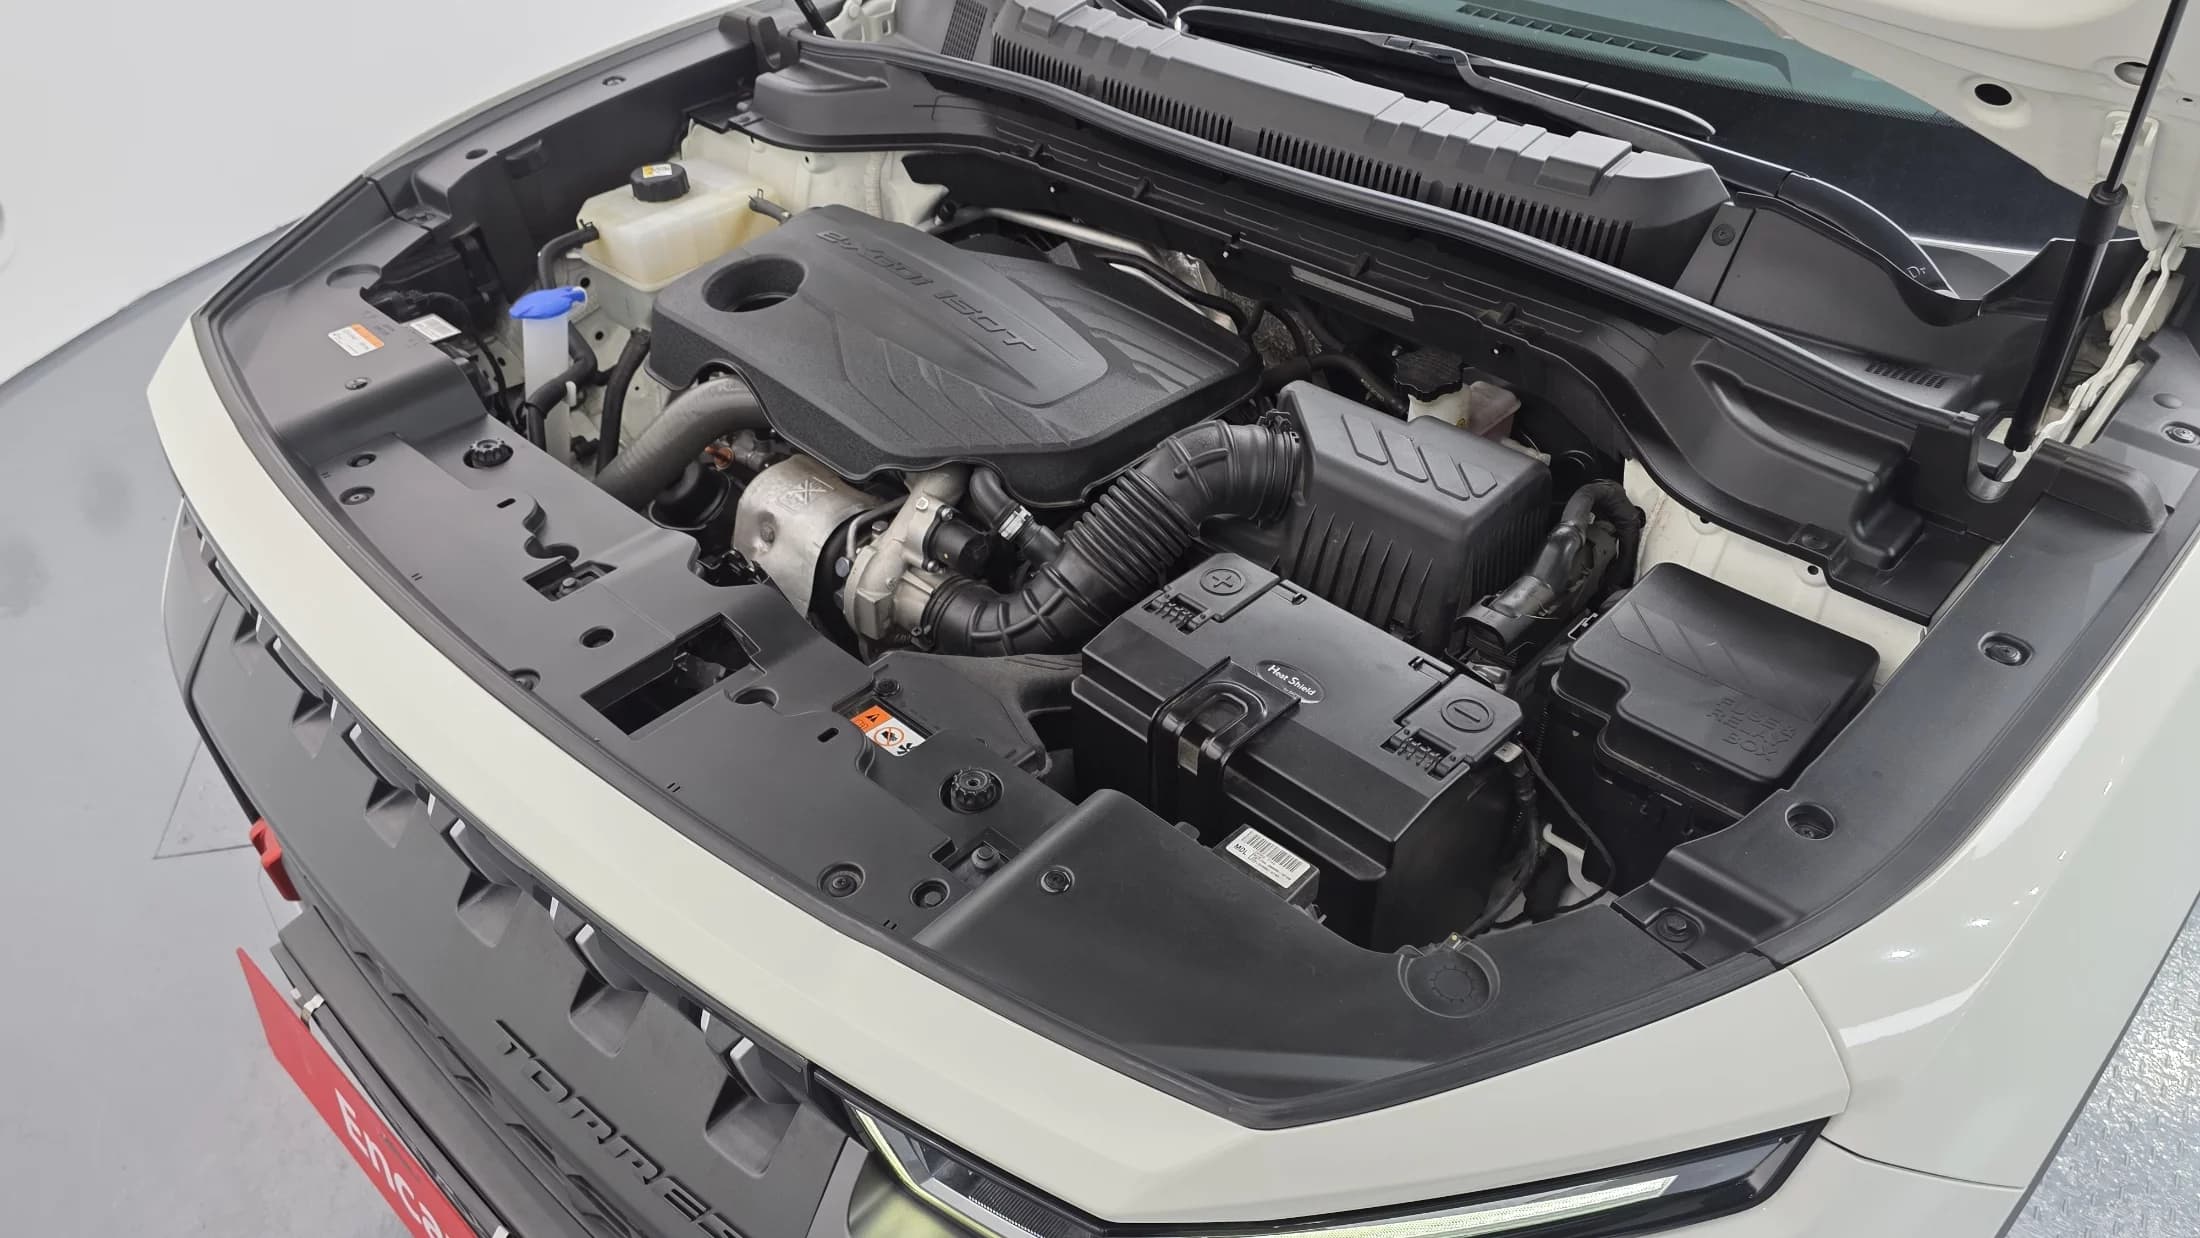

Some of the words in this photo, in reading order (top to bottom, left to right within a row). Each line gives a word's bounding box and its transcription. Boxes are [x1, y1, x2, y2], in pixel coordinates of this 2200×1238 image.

[933, 292, 1037, 352] 150T
[1267, 664, 1289, 681] Heat
[1287, 676, 1317, 696] Shield
[335, 1087, 451, 1238] Enca
